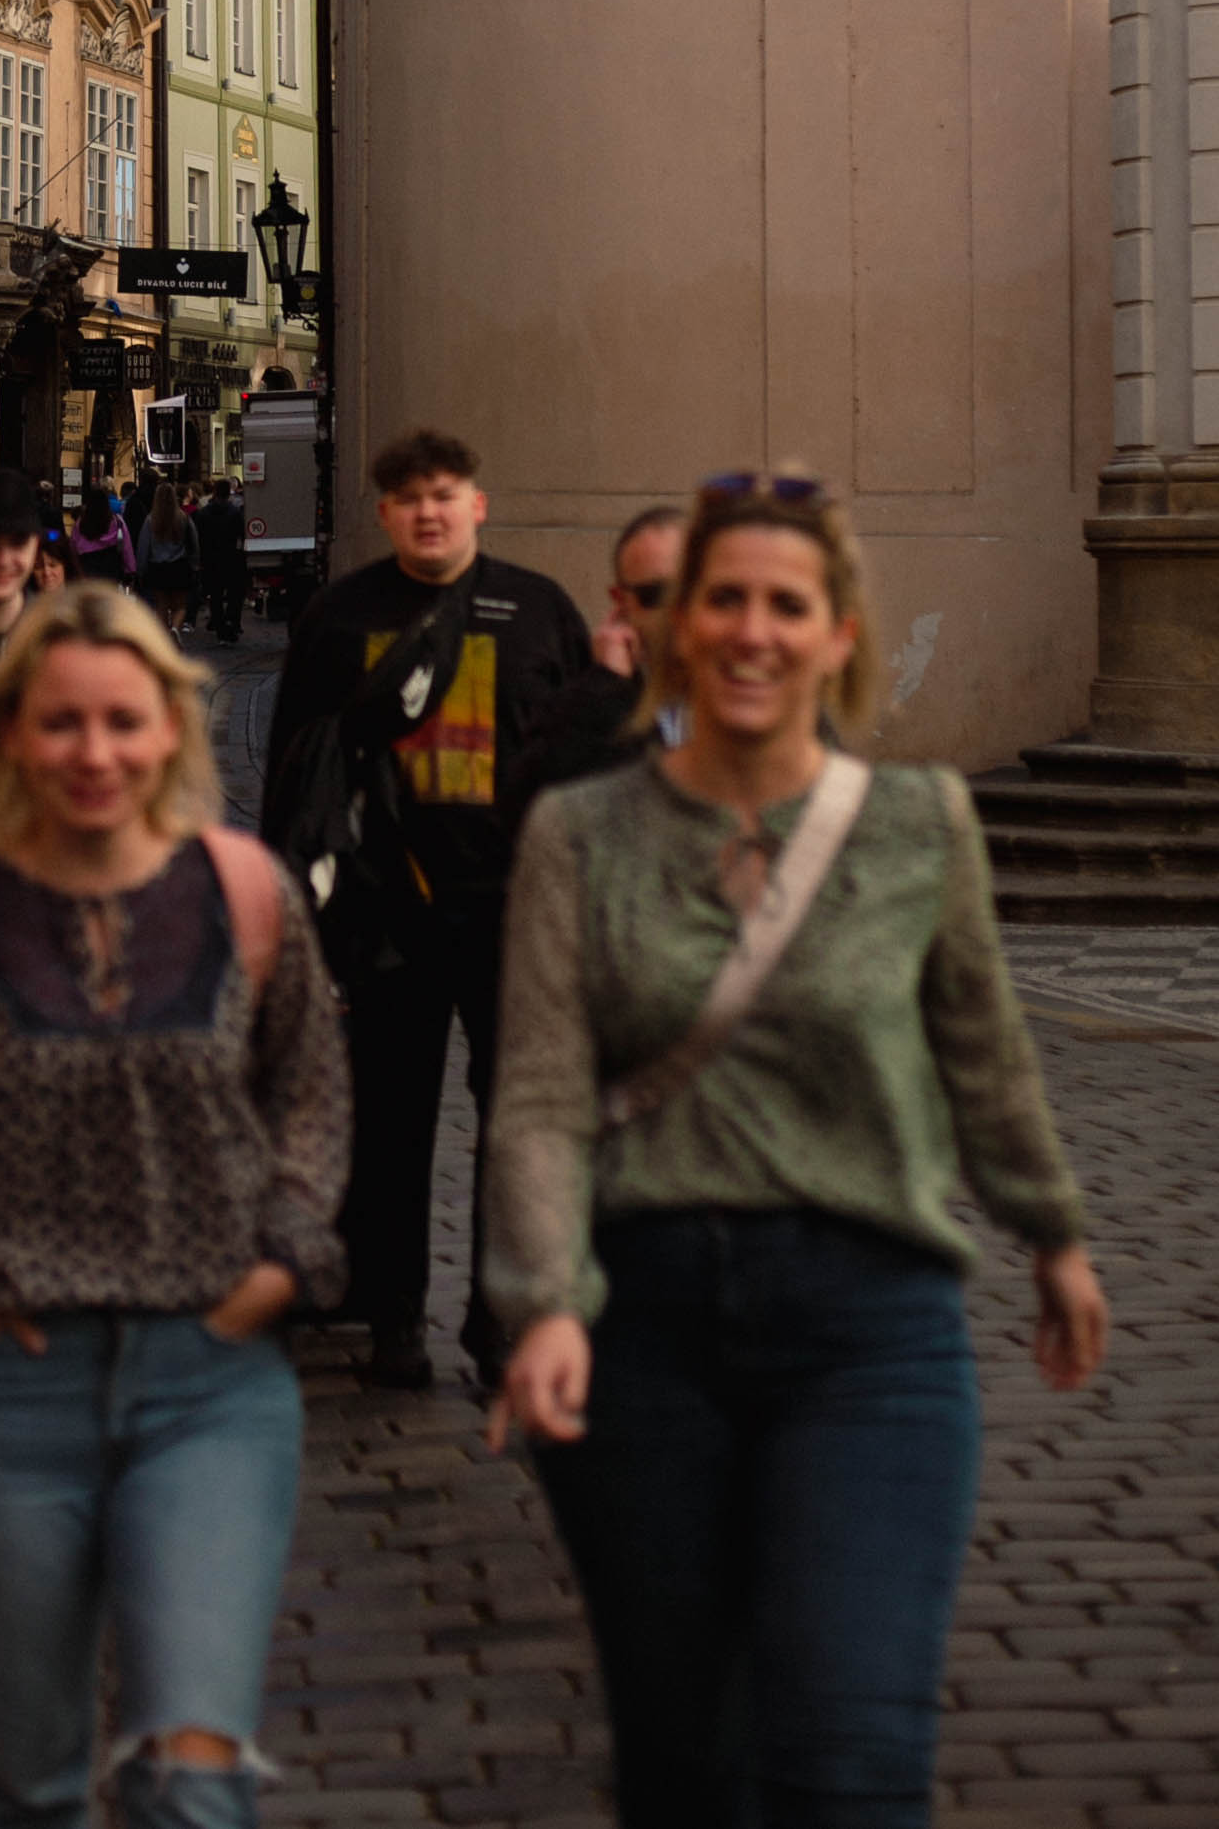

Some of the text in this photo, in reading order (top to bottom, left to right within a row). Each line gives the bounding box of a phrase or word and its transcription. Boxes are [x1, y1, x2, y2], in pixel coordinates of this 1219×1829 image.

[137, 279, 227, 290] DIVADLO LUCIE BÍLÉ
[127, 354, 151, 366] GOOD
[251, 523, 262, 532] 90
